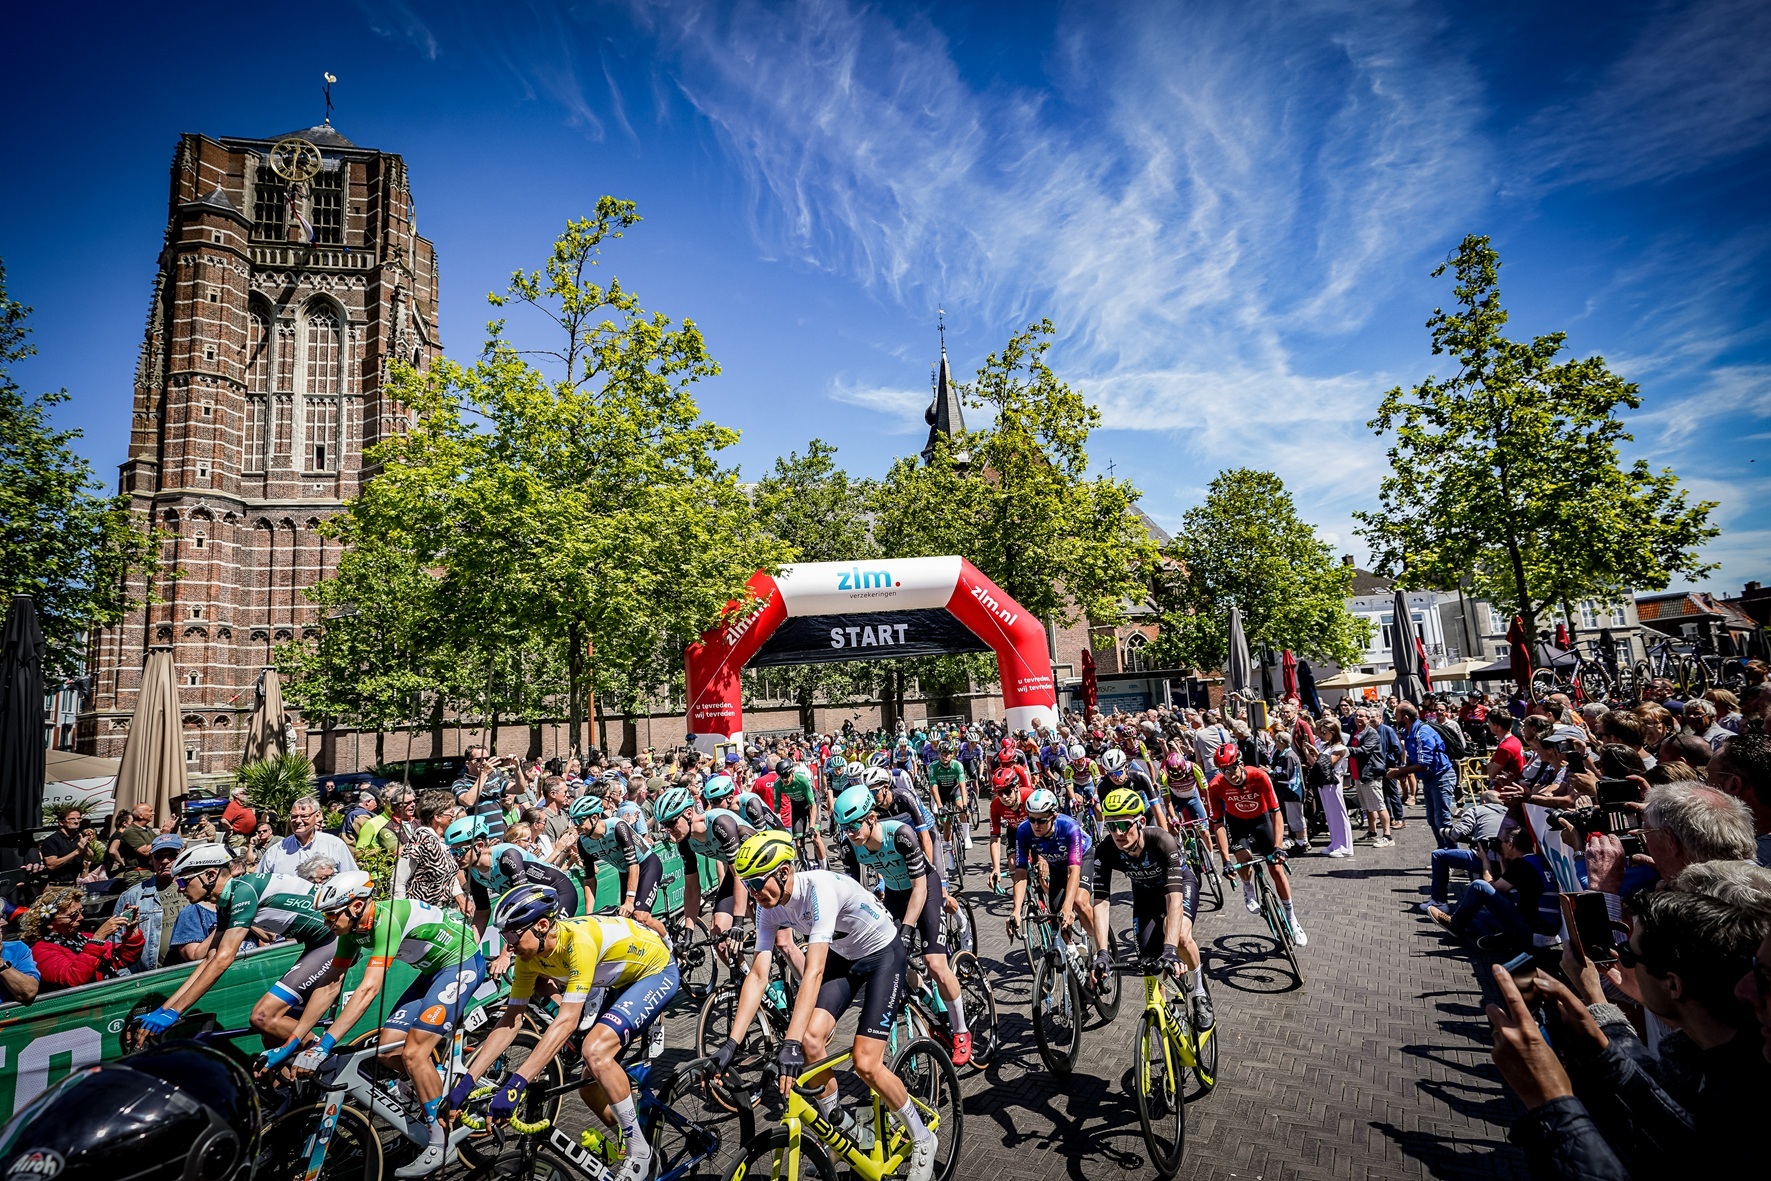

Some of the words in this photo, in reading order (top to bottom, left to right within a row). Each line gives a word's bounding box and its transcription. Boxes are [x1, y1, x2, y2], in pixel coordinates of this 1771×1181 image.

[850, 591, 897, 599] verzekeringen
[971, 585, 1018, 627] zlm.nl
[830, 624, 909, 649] START
[1017, 684, 1028, 692] wij
[694, 712, 705, 720] wij
[705, 710, 736, 718] tevreden
[862, 794, 872, 812] BEAT
[1228, 792, 1260, 802] ARKEA
[645, 881, 658, 908] BEAT
[937, 905, 948, 947] BEAT
[434, 928, 454, 945] TOTO
[298, 958, 334, 991] VolkerW
[634, 976, 674, 1029] FANTINI
[642, 989, 654, 1002] VINI
[470, 1011, 484, 1026] 31
[653, 1031, 664, 1046] 43
[550, 1128, 616, 1181] CUBE
[6, 1152, 58, 1176] Airoh
